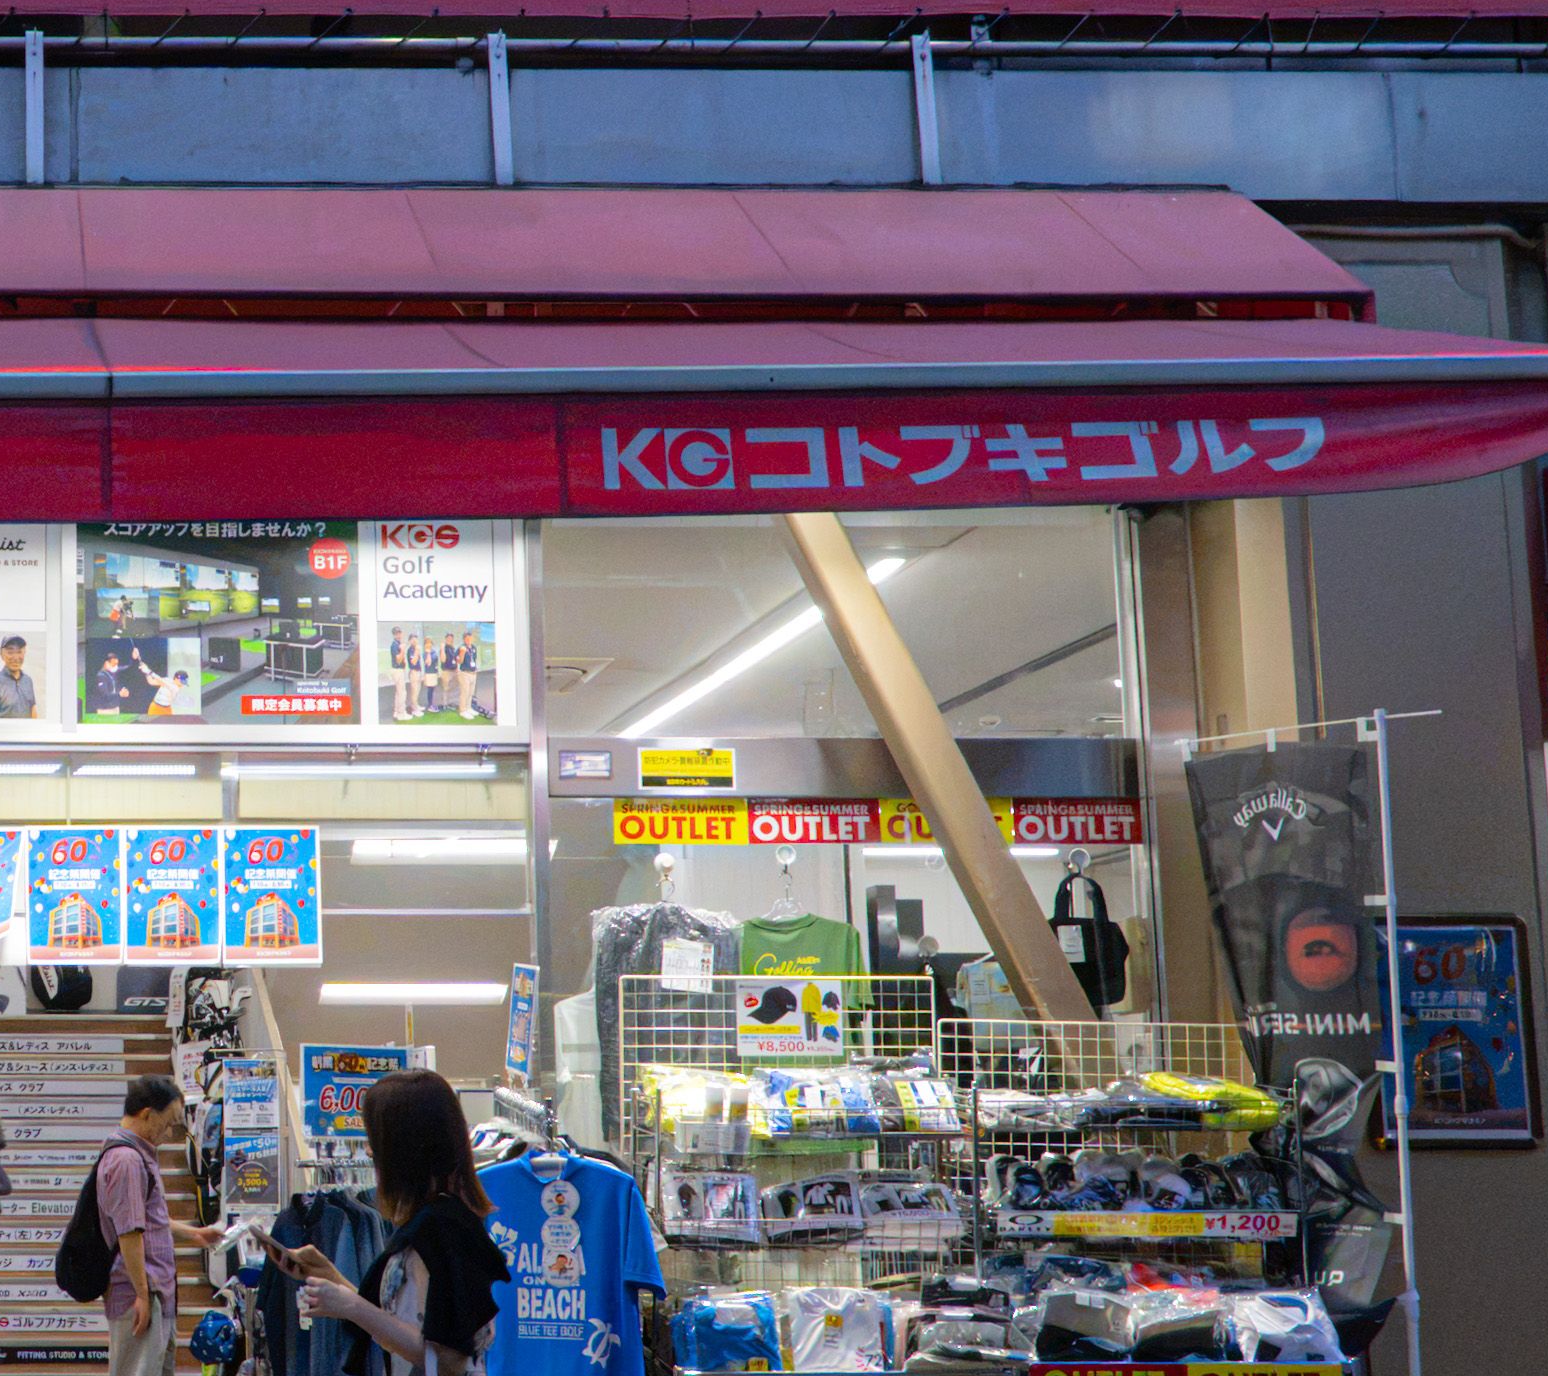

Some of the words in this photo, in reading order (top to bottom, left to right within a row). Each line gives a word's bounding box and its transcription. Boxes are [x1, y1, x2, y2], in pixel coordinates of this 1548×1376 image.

[744, 416, 1326, 489] コトブキゴルフ
[11, 559, 39, 567] STORE
[314, 555, 348, 570] B1F
[382, 555, 435, 575] Golf
[382, 580, 488, 603] Academy
[251, 698, 343, 712] 限定会員募集中
[619, 815, 737, 841] OUTLET
[751, 814, 872, 842] OUTLET
[1017, 815, 1137, 841] OUTLET
[1413, 946, 1467, 986] 60
[758, 1041, 805, 1052] ¥8,500
[30, 1201, 74, 1214] Elevator
[1204, 1214, 1281, 1232] ¥1,200
[517, 1287, 586, 1321] BEACH
[11, 1316, 99, 1328] ゴルフアカデミー
[543, 1325, 559, 1336] TEE
[16, 1350, 47, 1360] FITTING
[48, 1350, 77, 1360] STUDIO
